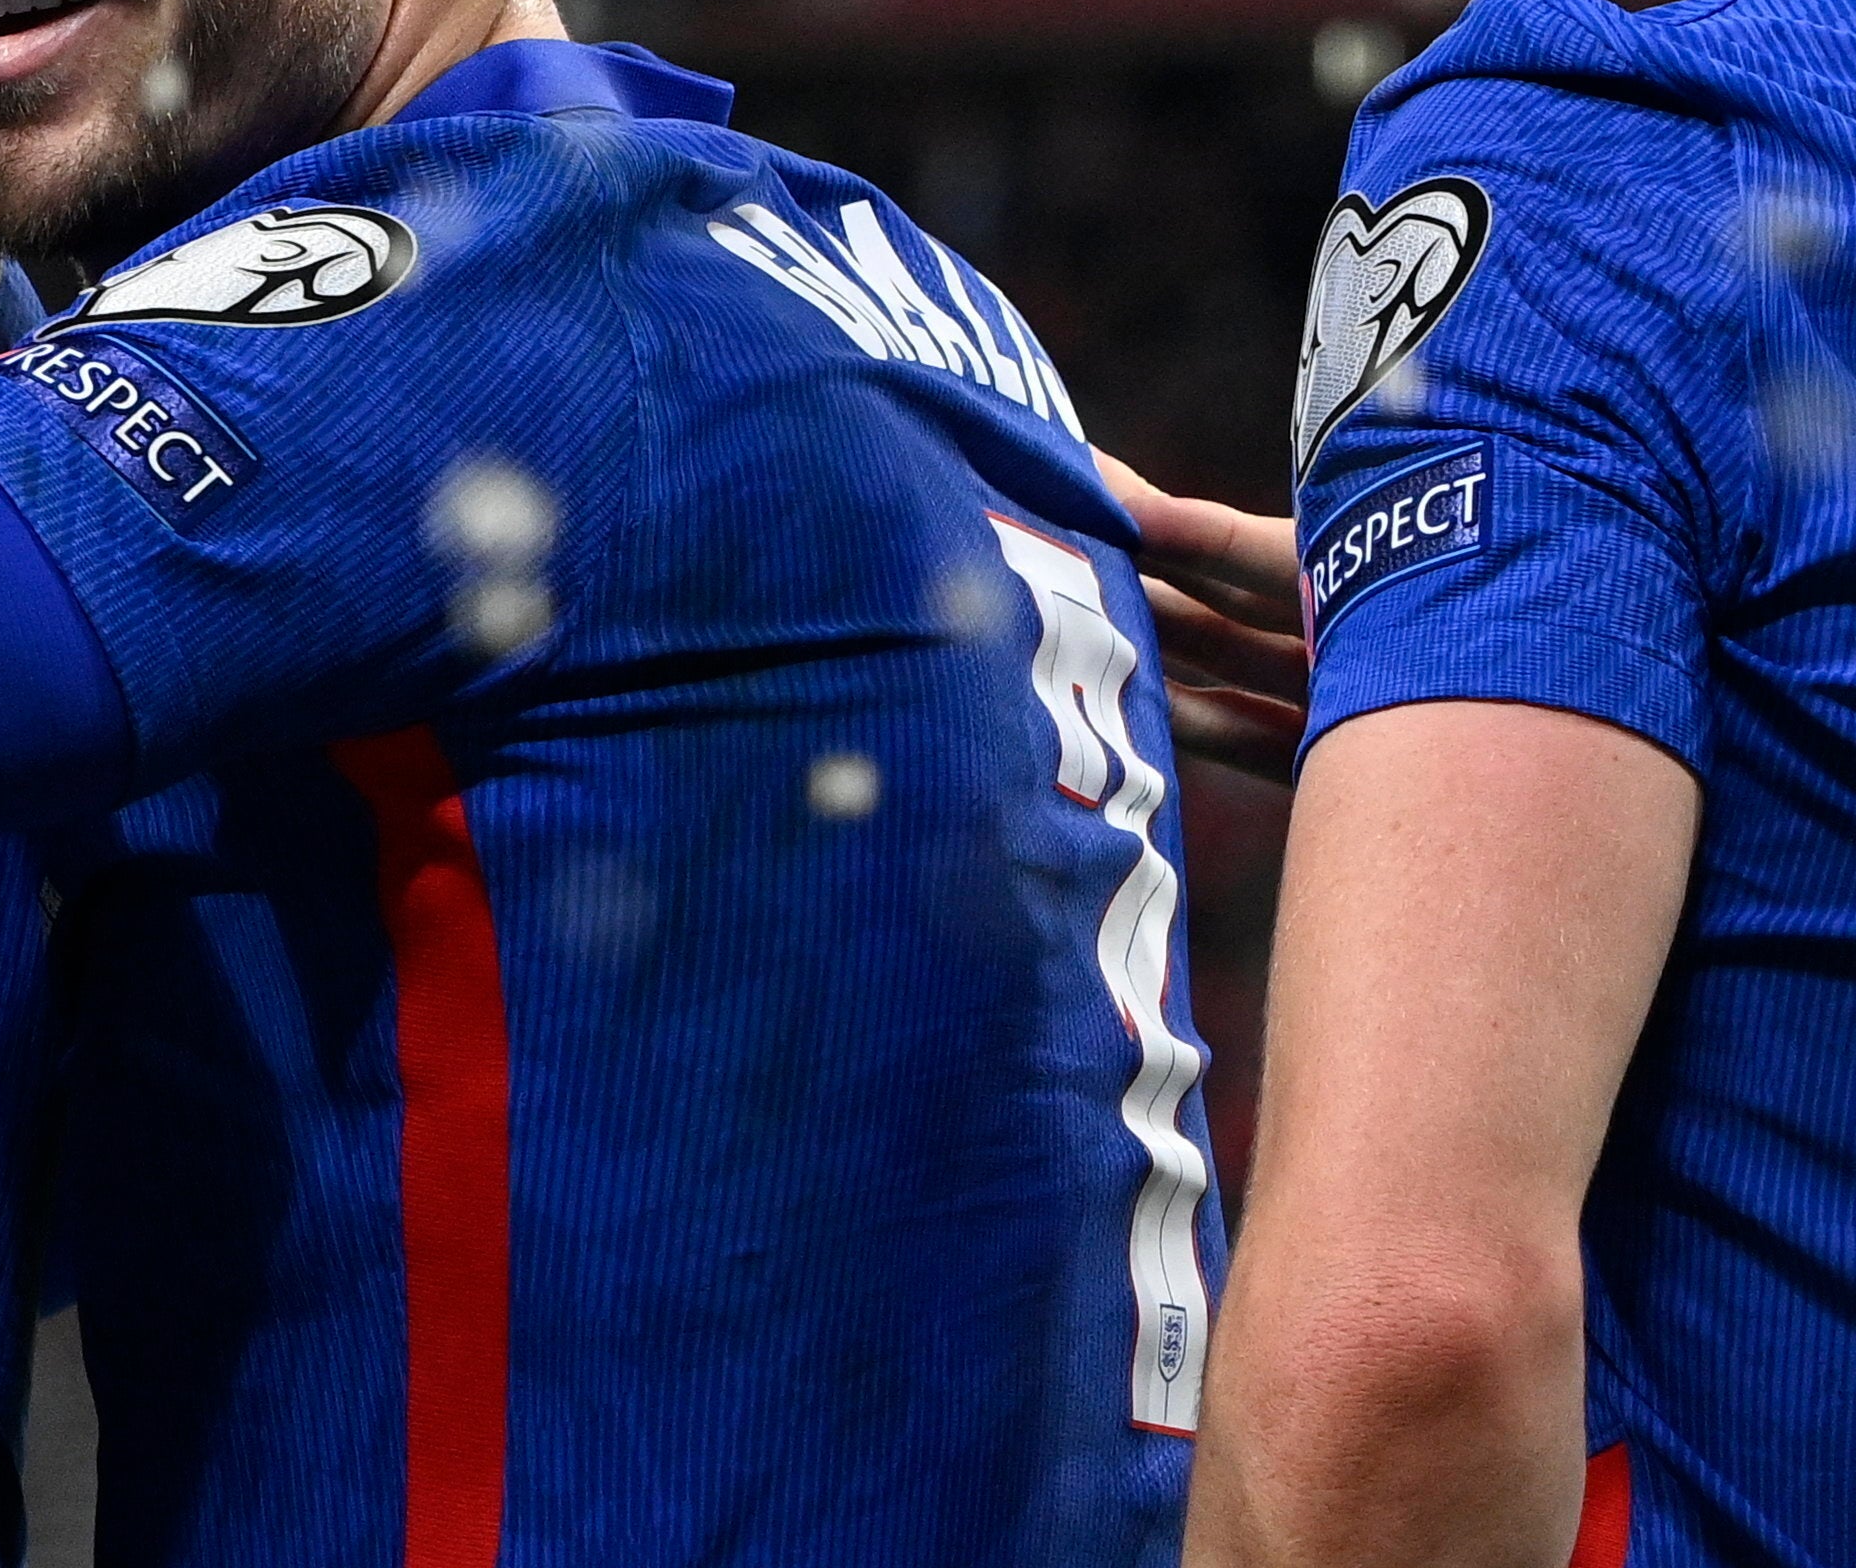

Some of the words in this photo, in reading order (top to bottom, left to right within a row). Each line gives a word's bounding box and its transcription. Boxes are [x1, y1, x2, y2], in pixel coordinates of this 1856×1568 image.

[4, 343, 234, 503] RESPECT
[1312, 472, 1487, 616] RESPECT
[985, 509, 1212, 1437] 7
